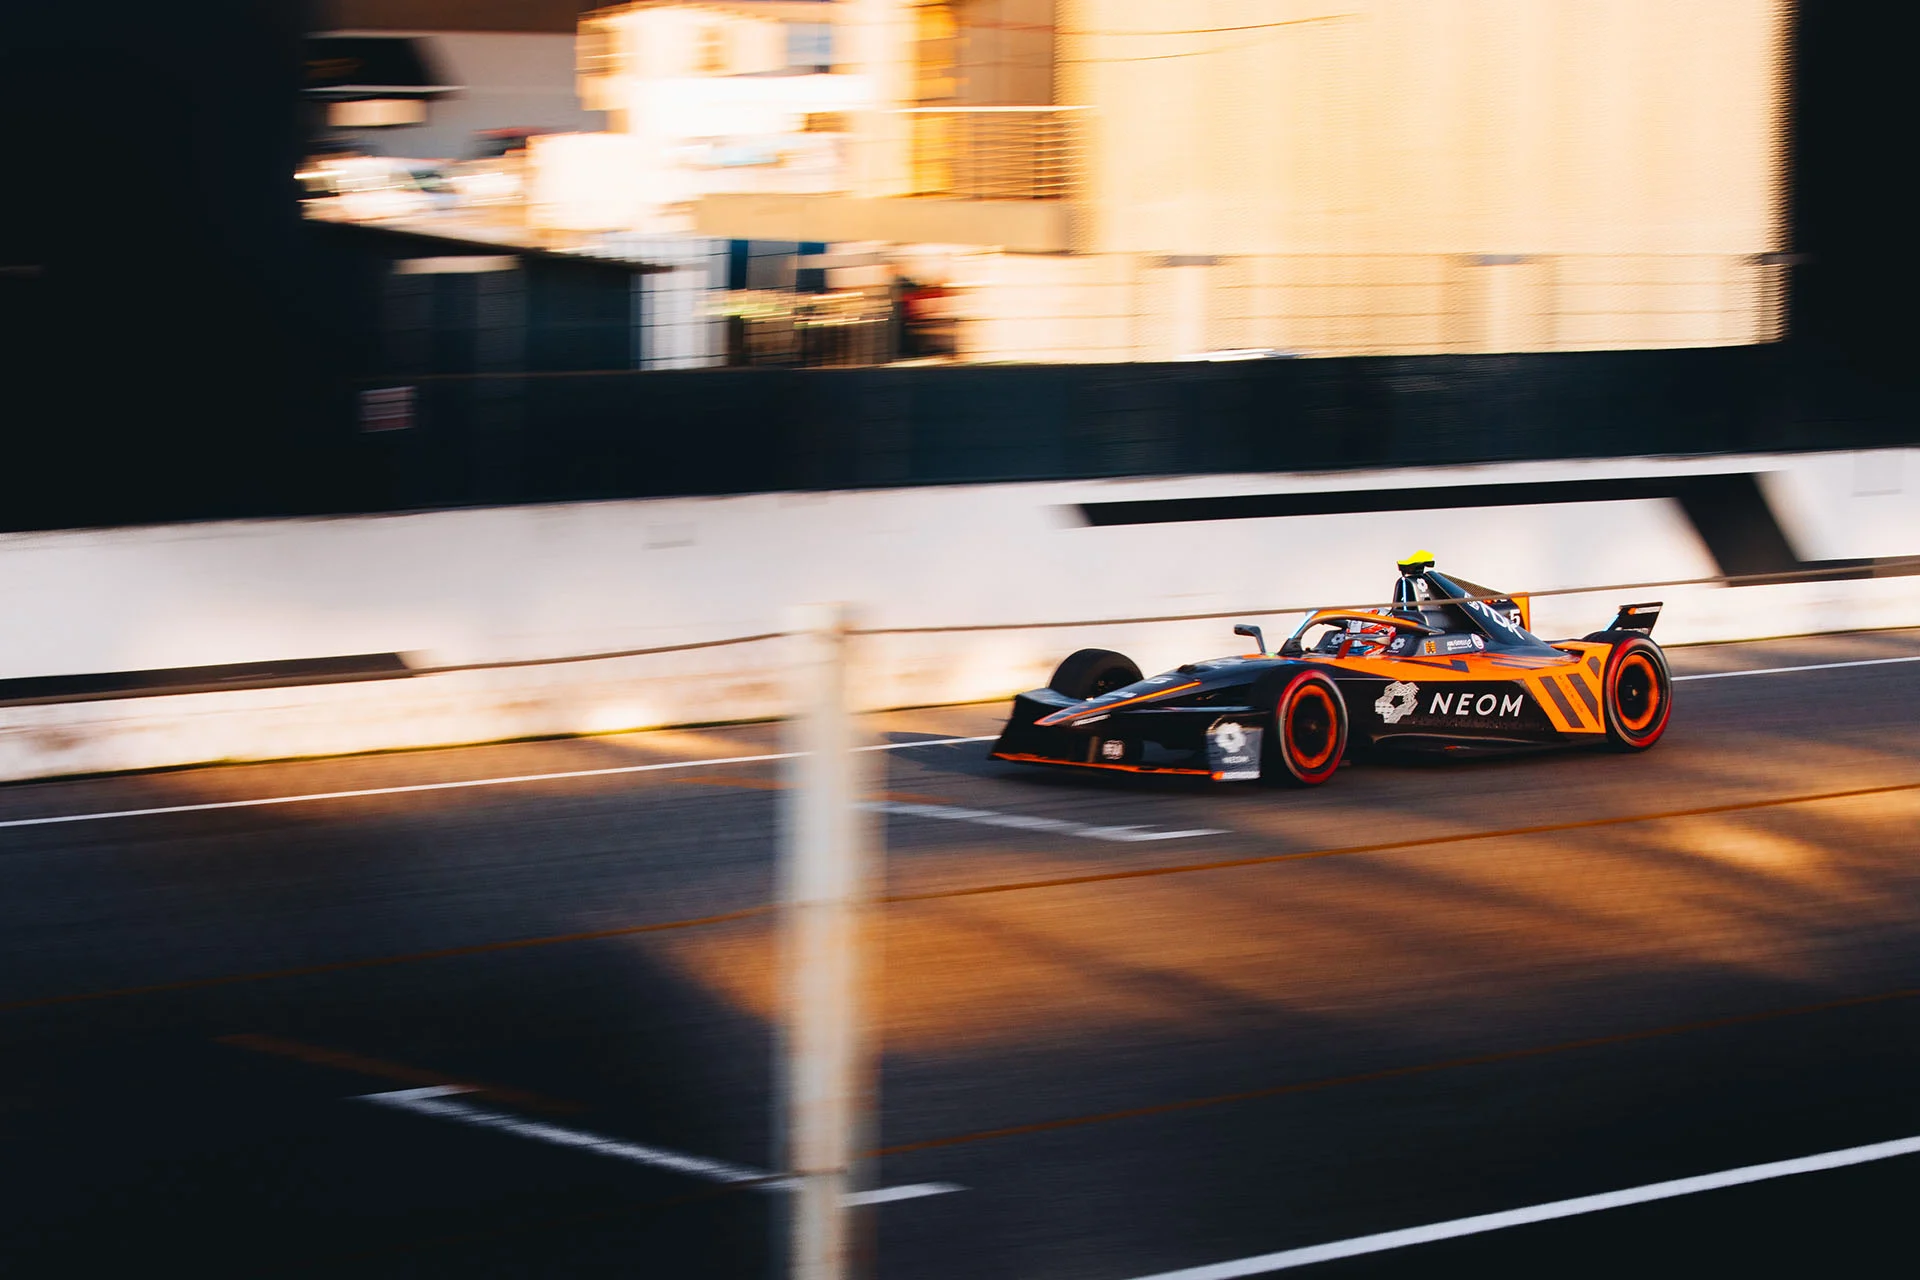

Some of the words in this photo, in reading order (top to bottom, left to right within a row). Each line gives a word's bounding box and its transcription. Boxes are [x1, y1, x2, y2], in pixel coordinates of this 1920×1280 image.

[1476, 600, 1525, 640] TDK
[1509, 608, 1521, 628] 5
[1429, 692, 1524, 717] NEOM
